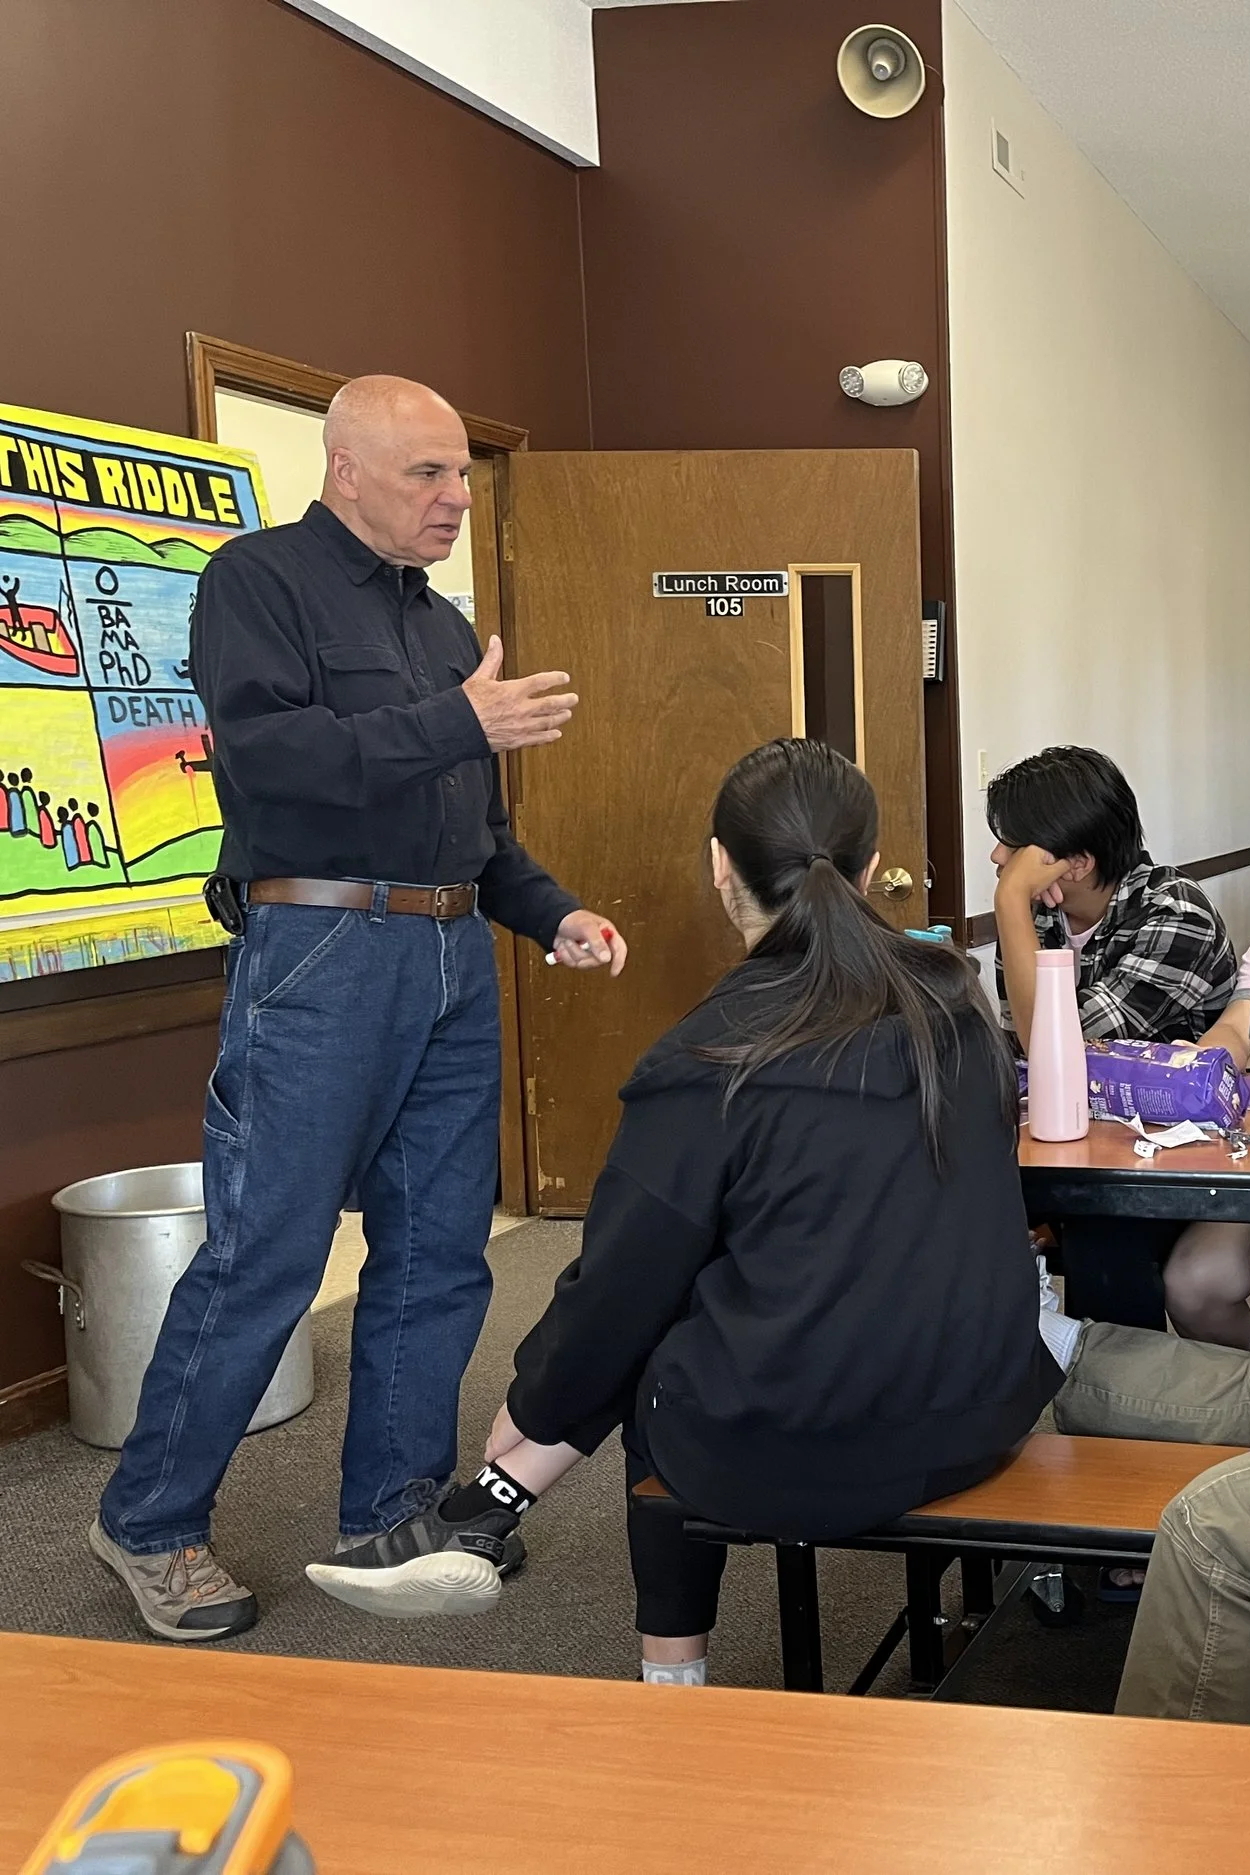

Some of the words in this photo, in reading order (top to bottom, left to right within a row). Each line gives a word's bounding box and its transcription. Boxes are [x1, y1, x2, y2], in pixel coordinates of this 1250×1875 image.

[0, 435, 90, 502] THIS
[93, 456, 240, 525] RIDDLE
[661, 575, 718, 592] Lunch
[725, 575, 780, 592] Room
[707, 597, 742, 616] 105
[108, 695, 198, 729] DEATH
